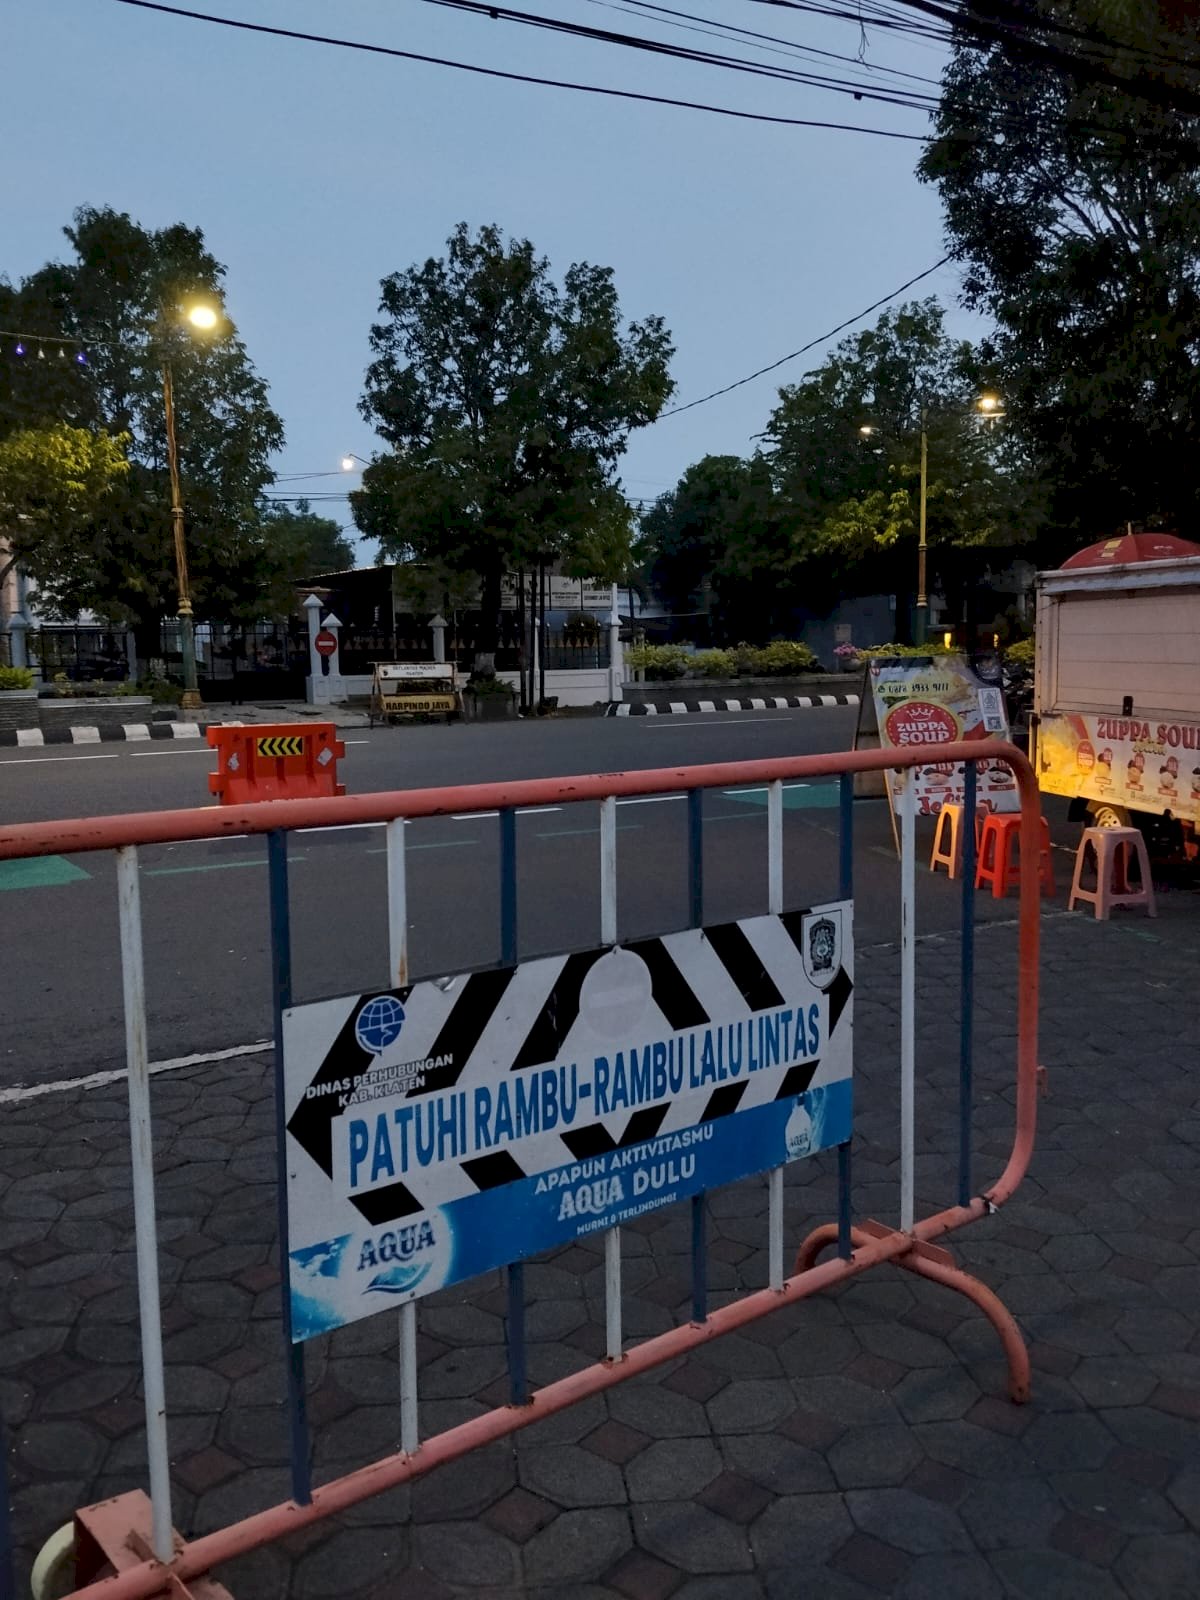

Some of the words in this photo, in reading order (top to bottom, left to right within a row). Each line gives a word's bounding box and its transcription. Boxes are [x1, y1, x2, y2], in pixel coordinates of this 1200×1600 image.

[432, 701, 450, 710] JAYA
[896, 721, 949, 732] ZUPPA
[899, 731, 950, 744] SOUP
[1097, 716, 1150, 742] ZUPPA
[305, 1078, 351, 1100] DINAS
[353, 1053, 454, 1088] PERHUBUNGAN
[338, 1087, 373, 1108] KAB.
[374, 1075, 426, 1099] KLATEN
[349, 1091, 467, 1188] PATUHI
[474, 1036, 684, 1151] RAMBU-RAMBU
[689, 1021, 743, 1089] LALU
[748, 1003, 820, 1073] LINTAS
[534, 1157, 605, 1196] APAPUN
[610, 1123, 714, 1171] AKTIVITASMU
[557, 1175, 625, 1222] AQUA
[633, 1153, 696, 1197] DULU
[576, 1217, 609, 1236] MURNI
[618, 1192, 677, 1220] TERLINDUNGI
[357, 1219, 436, 1272] AQUA
